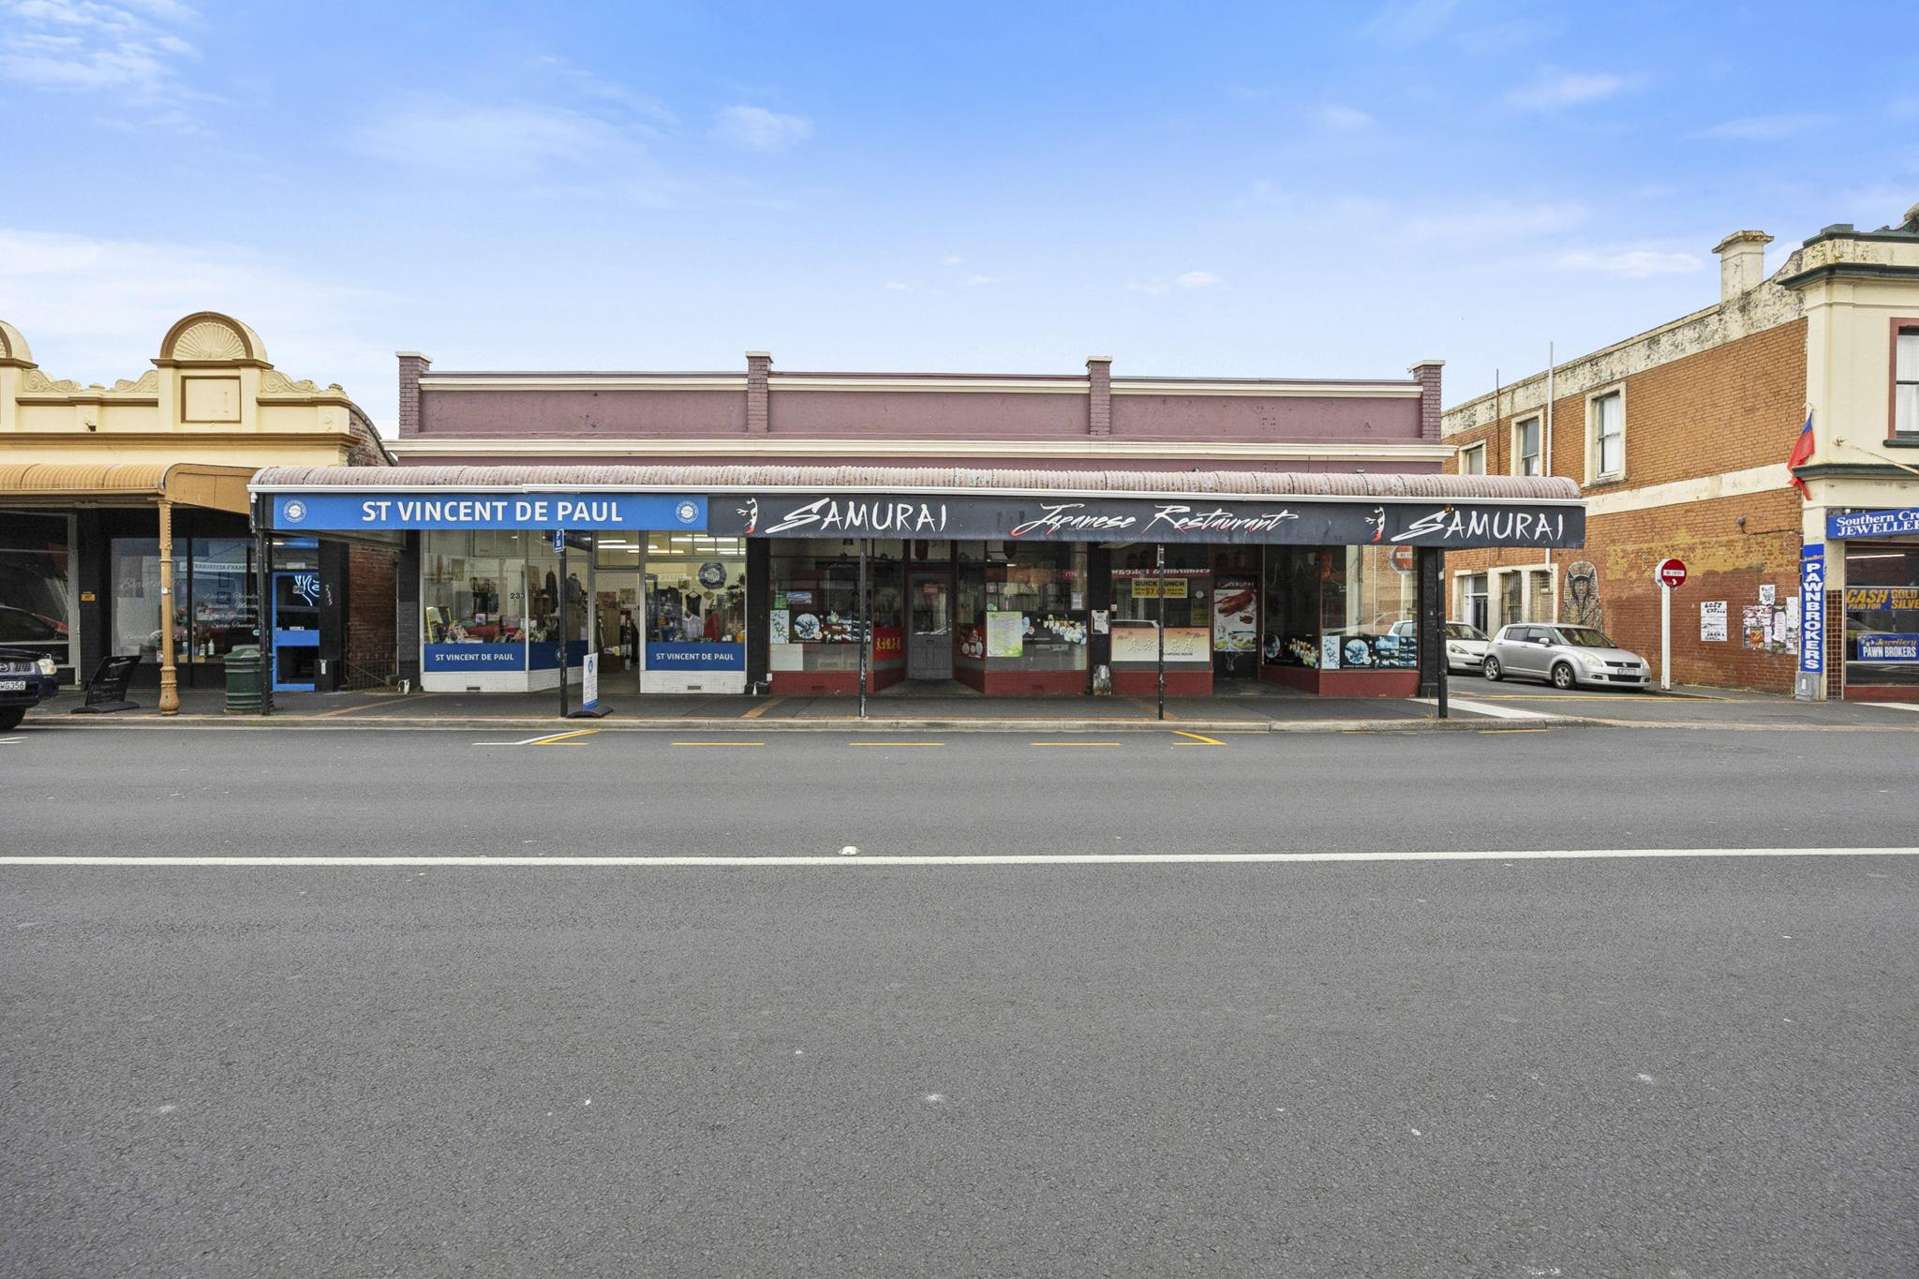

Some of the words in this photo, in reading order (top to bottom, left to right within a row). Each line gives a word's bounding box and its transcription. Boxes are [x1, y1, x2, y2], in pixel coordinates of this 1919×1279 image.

[362, 502, 391, 521] ST
[397, 501, 507, 521] VINCENT
[515, 502, 548, 521] DE
[557, 502, 623, 521] PAUL
[764, 497, 947, 534] SAMURAI
[1009, 503, 1137, 537] Japanese
[1141, 504, 1299, 534] Restaurant
[1390, 502, 1563, 542] SAMURAI
[1836, 514, 1895, 526] Southern
[1847, 589, 1889, 604] CASH
[1803, 563, 1823, 669] PAWNBROKERS
[1863, 647, 1883, 657] PAWN
[1884, 647, 1917, 657] BROKERS
